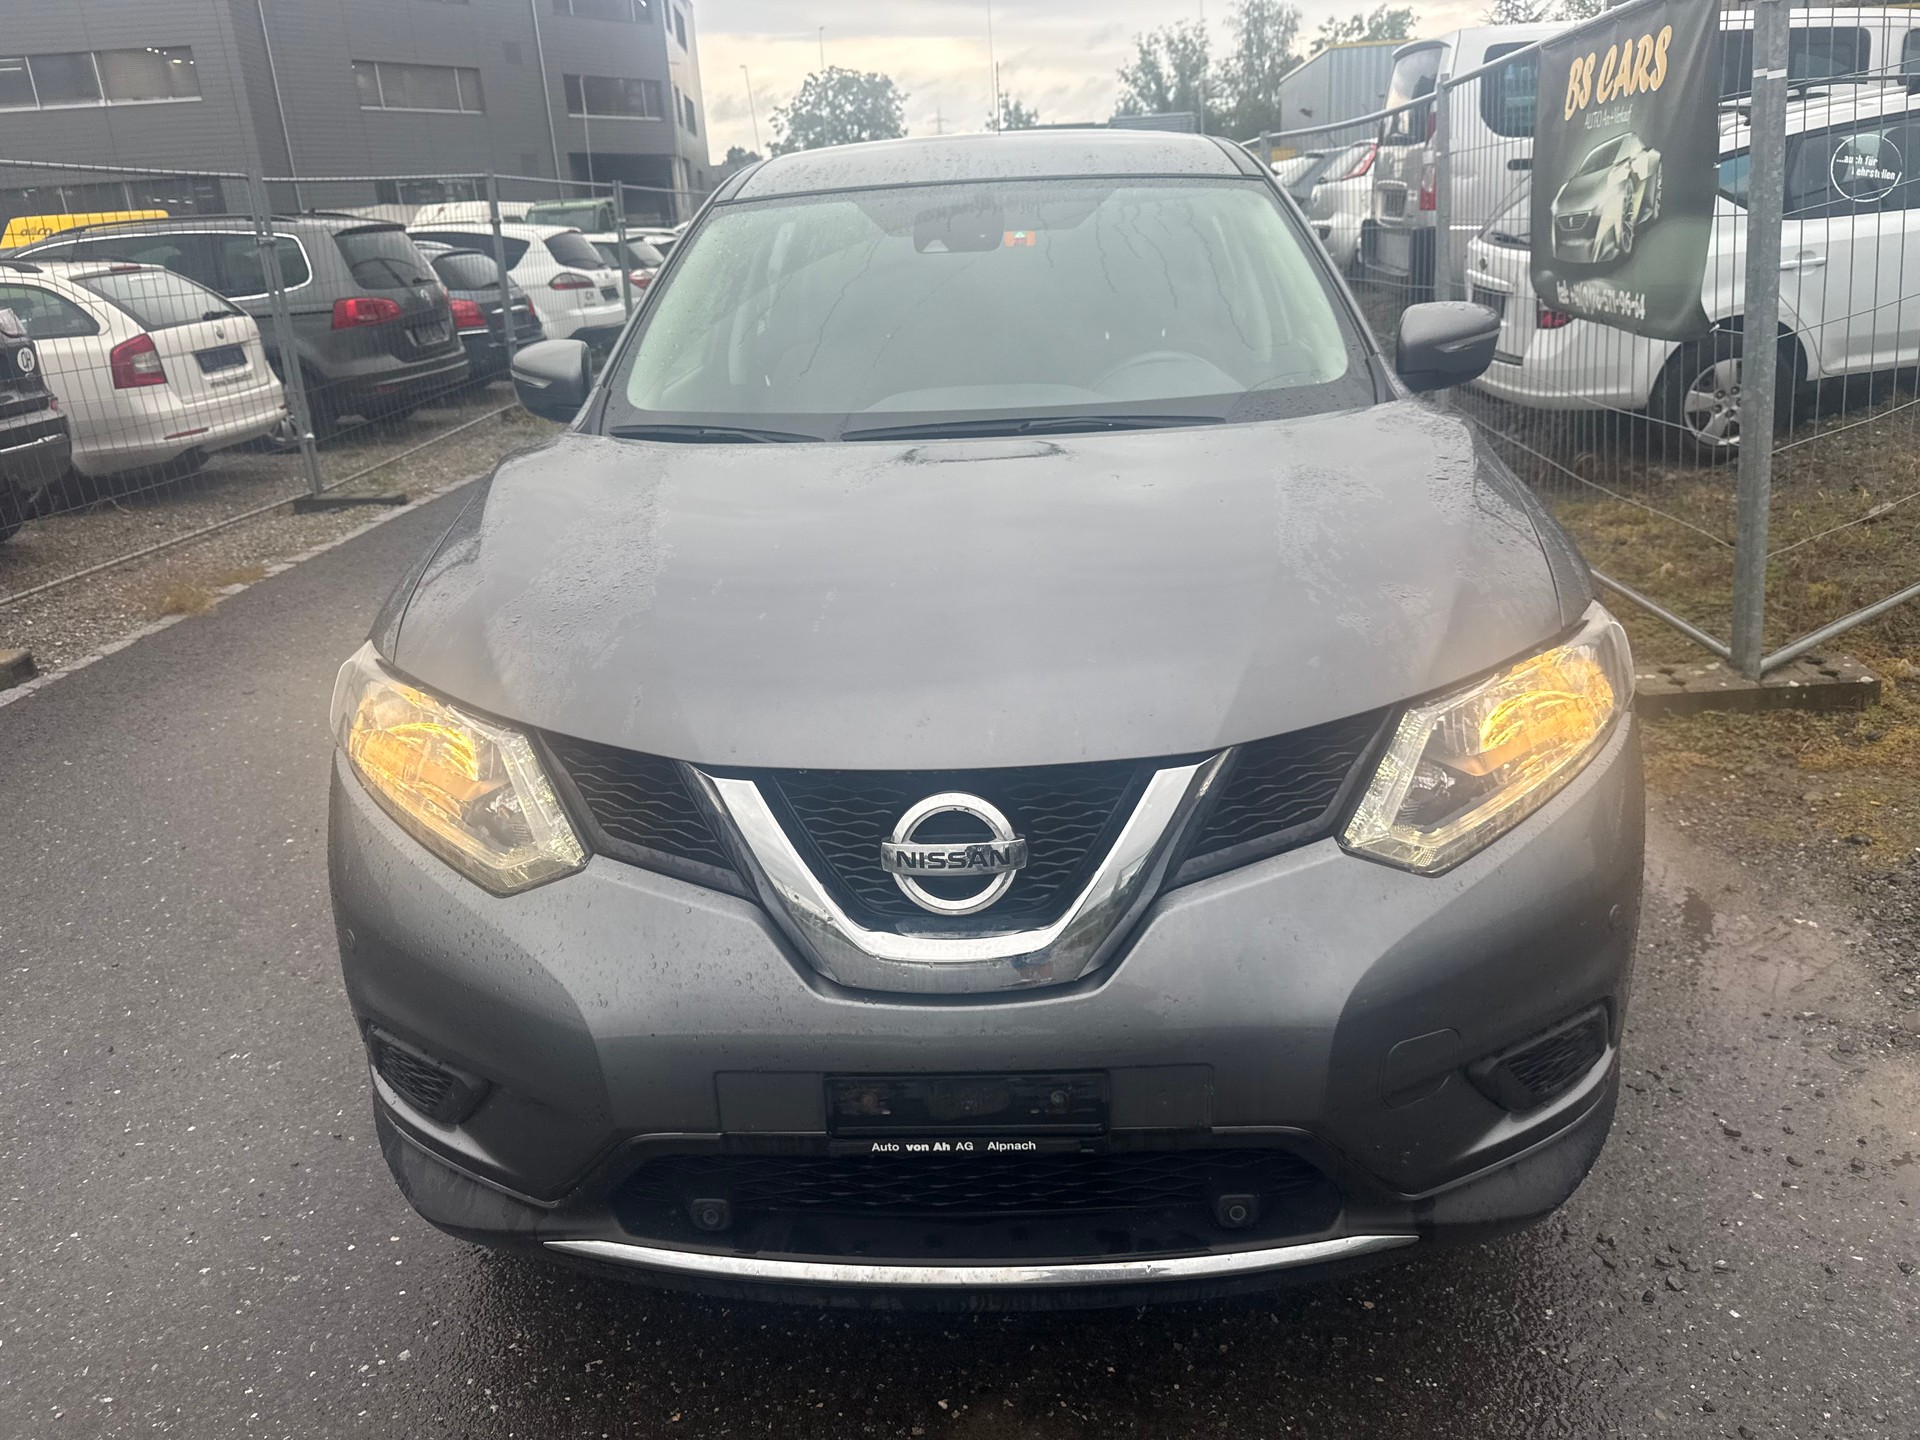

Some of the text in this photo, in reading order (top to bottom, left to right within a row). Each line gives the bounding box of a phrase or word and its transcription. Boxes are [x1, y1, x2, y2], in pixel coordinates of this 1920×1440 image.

[1564, 25, 1672, 121] BS CARS
[1865, 155, 1878, 166] für
[896, 848, 1010, 869] NISSAN
[871, 1140, 1037, 1153] Auto von Ah AG Alpnach
